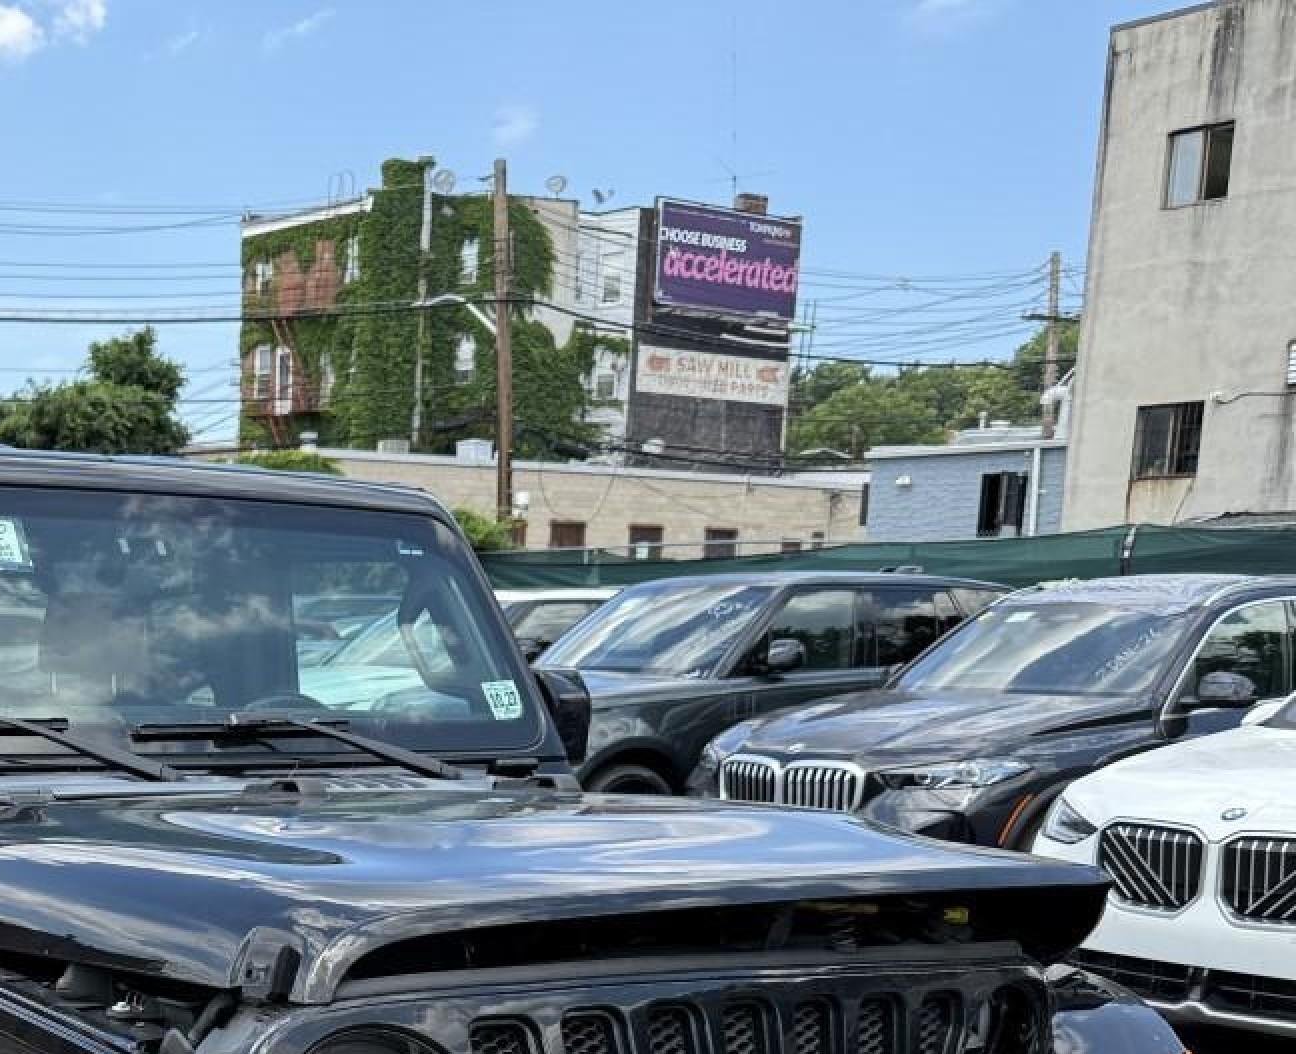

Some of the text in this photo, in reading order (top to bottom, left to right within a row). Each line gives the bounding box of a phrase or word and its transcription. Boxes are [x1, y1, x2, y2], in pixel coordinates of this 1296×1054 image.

[659, 227, 701, 246] CHOOSE
[701, 233, 747, 253] BUSINESS
[663, 249, 797, 293] accelerated
